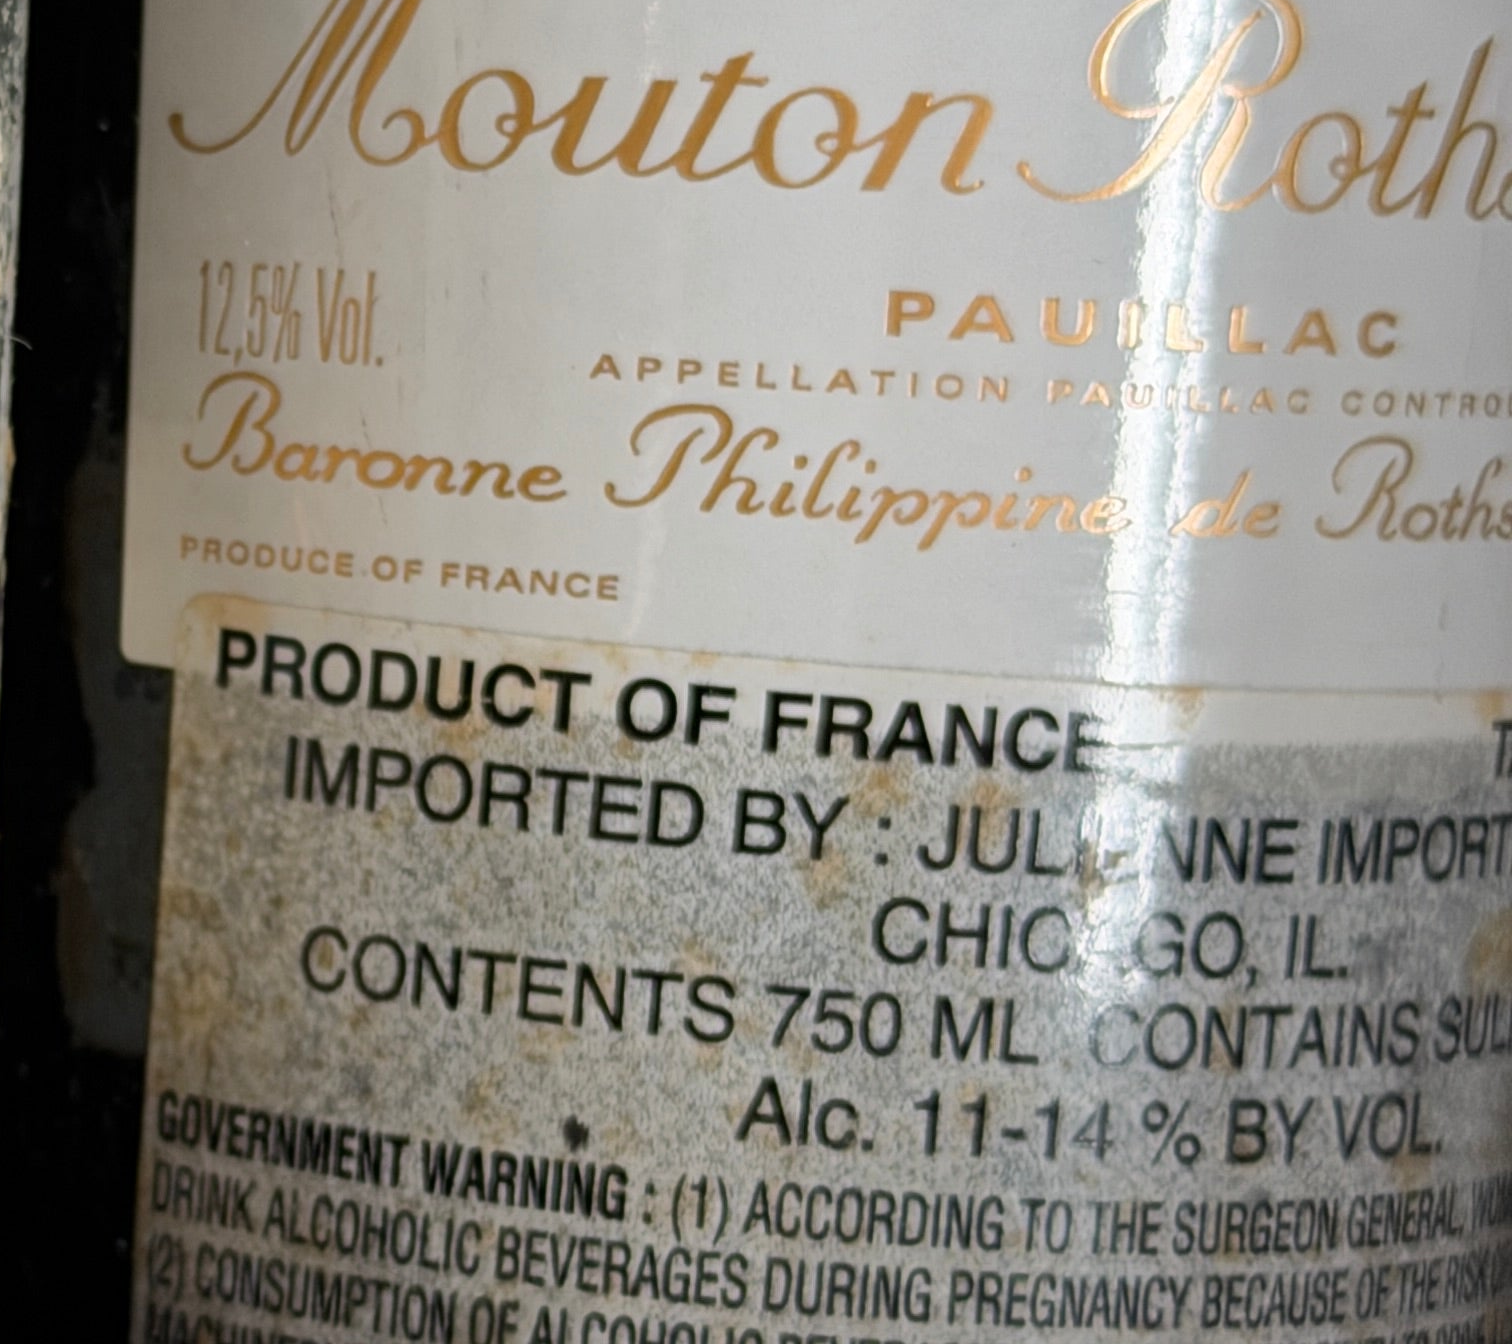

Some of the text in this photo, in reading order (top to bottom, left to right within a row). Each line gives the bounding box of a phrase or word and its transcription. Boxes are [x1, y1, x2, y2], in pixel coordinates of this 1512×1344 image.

[197, 259, 385, 367] 12,5% Vol.
[885, 289, 1399, 359] PAUILLAC
[588, 354, 1010, 404] APPELLATION
[1046, 378, 1312, 416] PAUILLAC
[181, 370, 568, 503] Baronne
[603, 402, 1132, 551] Philippine
[1169, 468, 1284, 539] de
[180, 534, 621, 602] PRODUCE OF FRANCE
[215, 627, 1106, 775] PRODUCT OF FRANCE
[286, 735, 706, 848] IMPORTED
[732, 788, 851, 862] BY
[917, 803, 1300, 883] JULNNE
[300, 925, 739, 1044] CONTENTS
[765, 982, 903, 1058] 750
[929, 993, 1040, 1066] ML
[1092, 1000, 1422, 1071] CONTAINS
[871, 897, 1350, 990] CHICGO, IL.
[157, 1089, 410, 1188] GOVERNMENT
[421, 1139, 628, 1223] WARNING
[671, 1173, 730, 1246] (1)
[743, 1180, 1005, 1252] ACCORDING
[1020, 1197, 1074, 1255] TO
[1089, 1197, 1162, 1257] THE
[1172, 1196, 1339, 1257] SURGEON
[914, 1089, 1115, 1166] 11-14
[1225, 1097, 1316, 1166] BY
[1331, 1093, 1443, 1161] VOL.
[150, 1159, 256, 1235] DRINK
[263, 1187, 483, 1278] ALCOHOLIC
[495, 1225, 749, 1309] BEVERAGES
[761, 1256, 932, 1324] DURING
[947, 1269, 1192, 1330] PREGNANCY
[1201, 1268, 1349, 1330] BECAUSE
[1355, 1261, 1392, 1322] OF
[1397, 1257, 1442, 1316] THE
